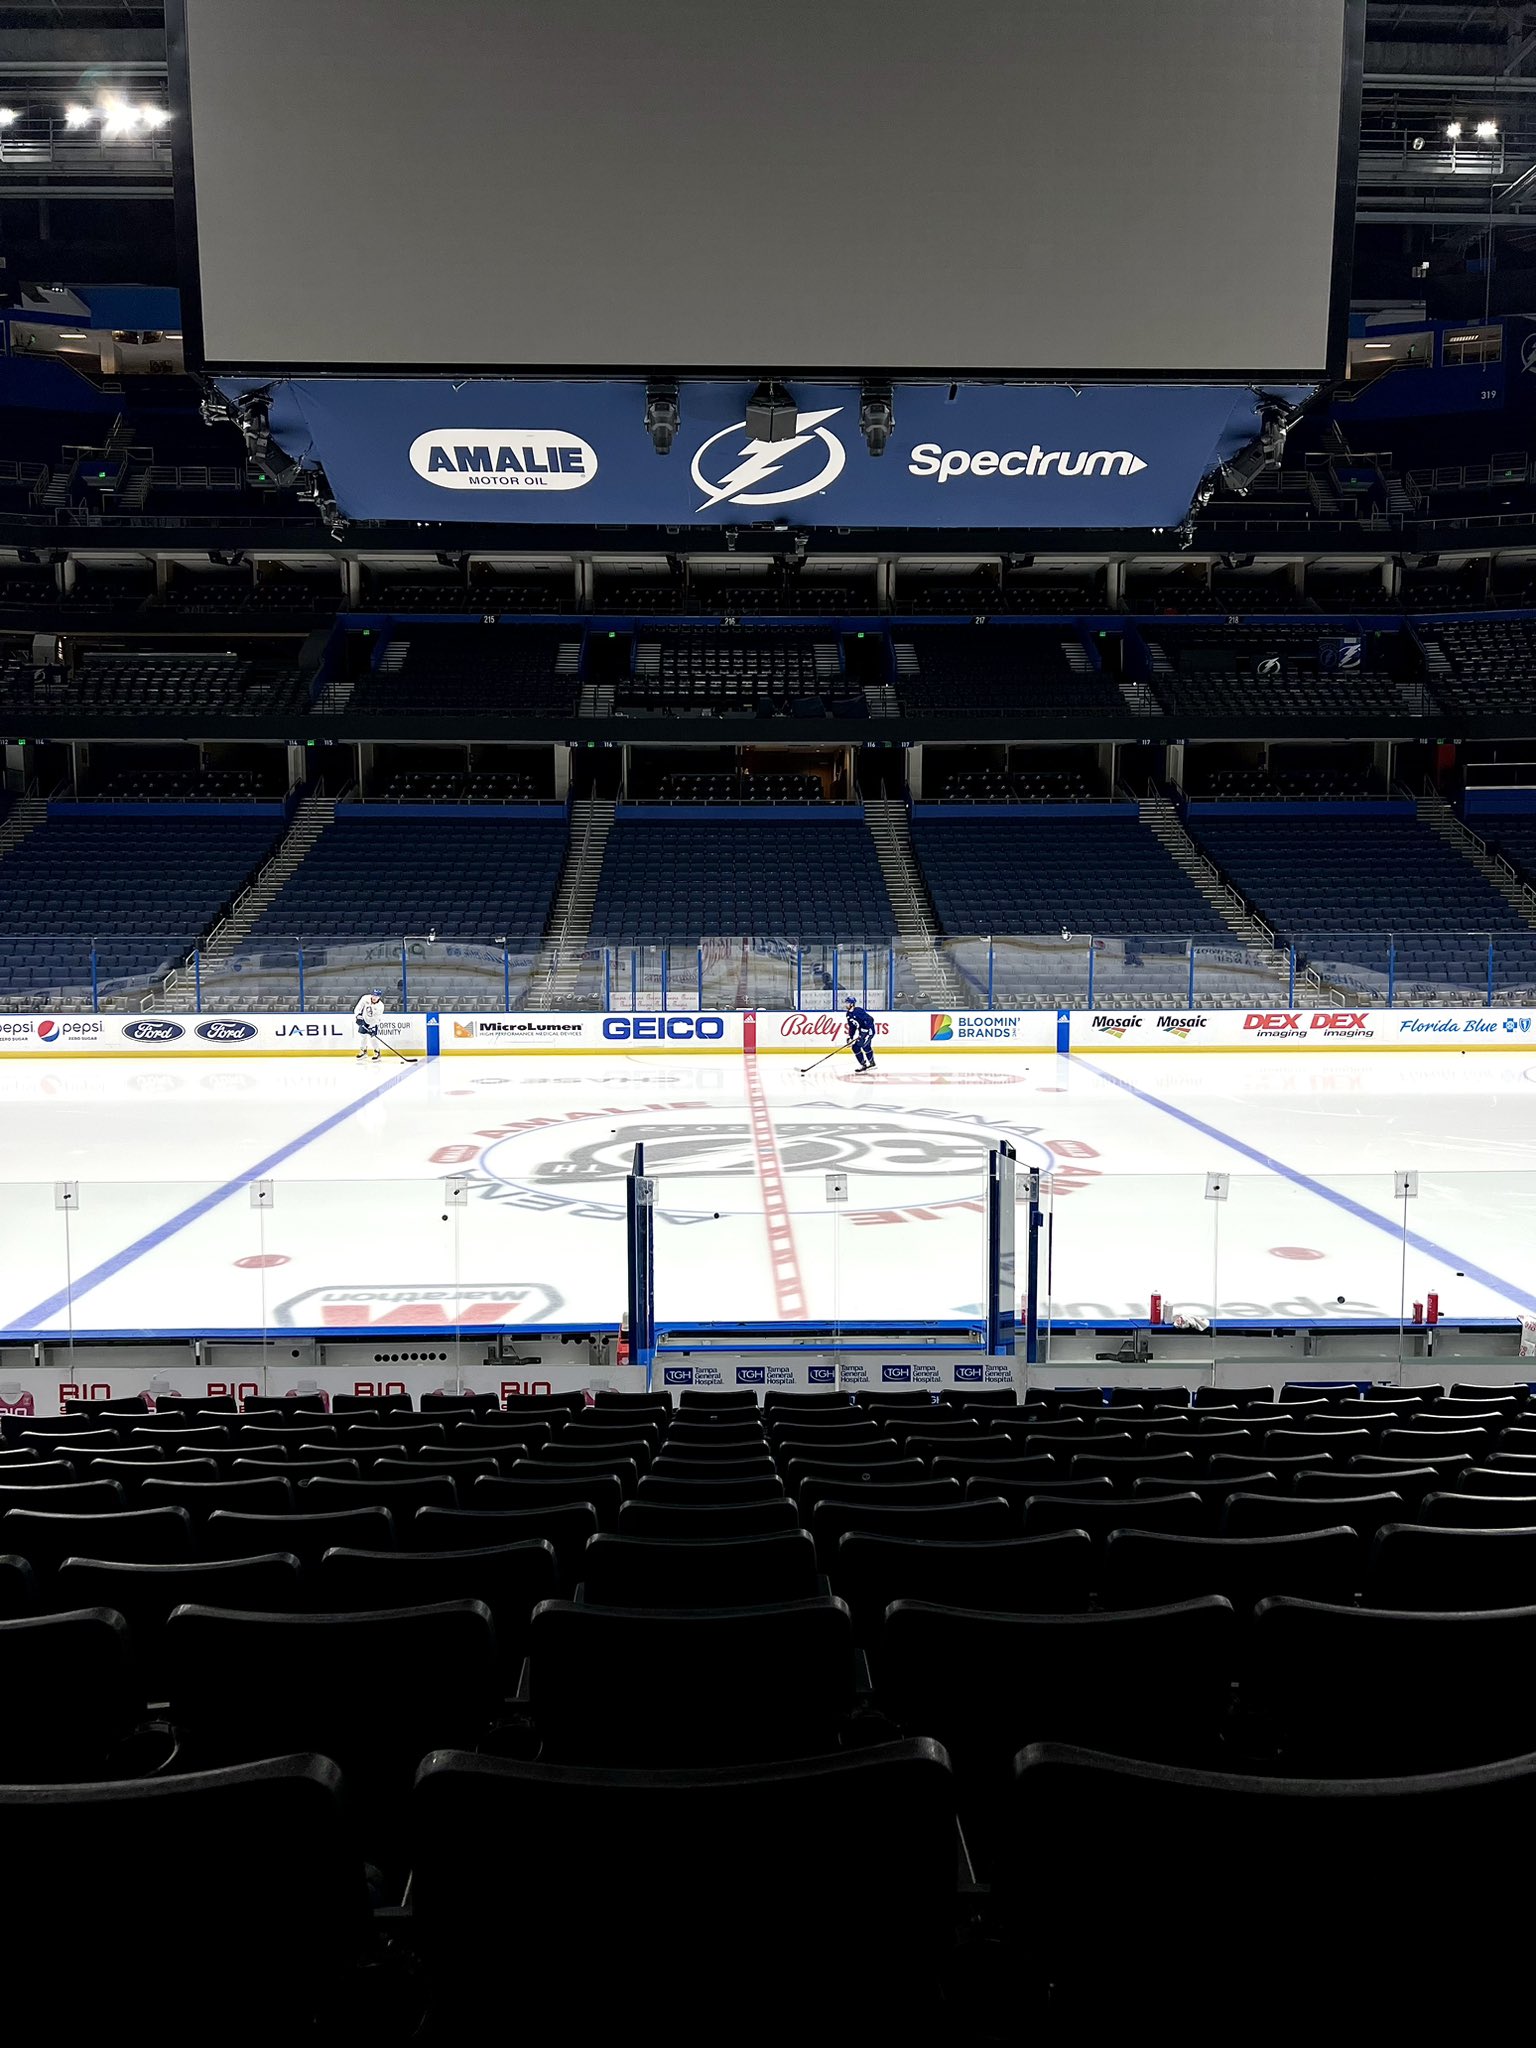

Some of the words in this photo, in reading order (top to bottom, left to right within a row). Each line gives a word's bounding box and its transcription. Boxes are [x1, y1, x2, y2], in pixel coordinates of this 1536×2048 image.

[1480, 390, 1497, 400] 319
[427, 445, 585, 475] AMALIE
[908, 443, 1133, 484] Spectrum
[468, 475, 513, 486] MOTOR
[516, 474, 548, 485] OIL
[483, 615, 495, 624] 215
[975, 616, 986, 624] 217
[62, 1020, 103, 1035] pepsi
[479, 1022, 582, 1031] MicroLumen
[780, 1013, 843, 1042] Bally
[844, 1022, 889, 1035] STS
[958, 1017, 1021, 1027] BLOOMIN'
[1092, 1015, 1143, 1028] Mosaic
[1156, 1015, 1207, 1028] Mosaic
[1243, 1013, 1302, 1030] DEX
[1310, 1013, 1370, 1030] DEX
[1399, 1018, 1460, 1034] Florida
[1463, 1018, 1498, 1032] Blue
[134, 1022, 174, 1039] Ford
[206, 1022, 246, 1039] Ford
[275, 1024, 343, 1036] JABIL
[602, 1017, 724, 1039] GEICO
[958, 1028, 1011, 1038] BRANDS
[1256, 1029, 1307, 1039] imaging
[1323, 1028, 1374, 1038] imaging
[472, 1101, 713, 1139] AMALIE
[790, 1101, 1044, 1136] ARENA
[321, 1288, 530, 1303] Marathon
[670, 1370, 691, 1380] TGH
[741, 1369, 763, 1379] TGH
[813, 1369, 835, 1378] TGH
[887, 1368, 909, 1377] TGH
[959, 1368, 981, 1377] TGH
